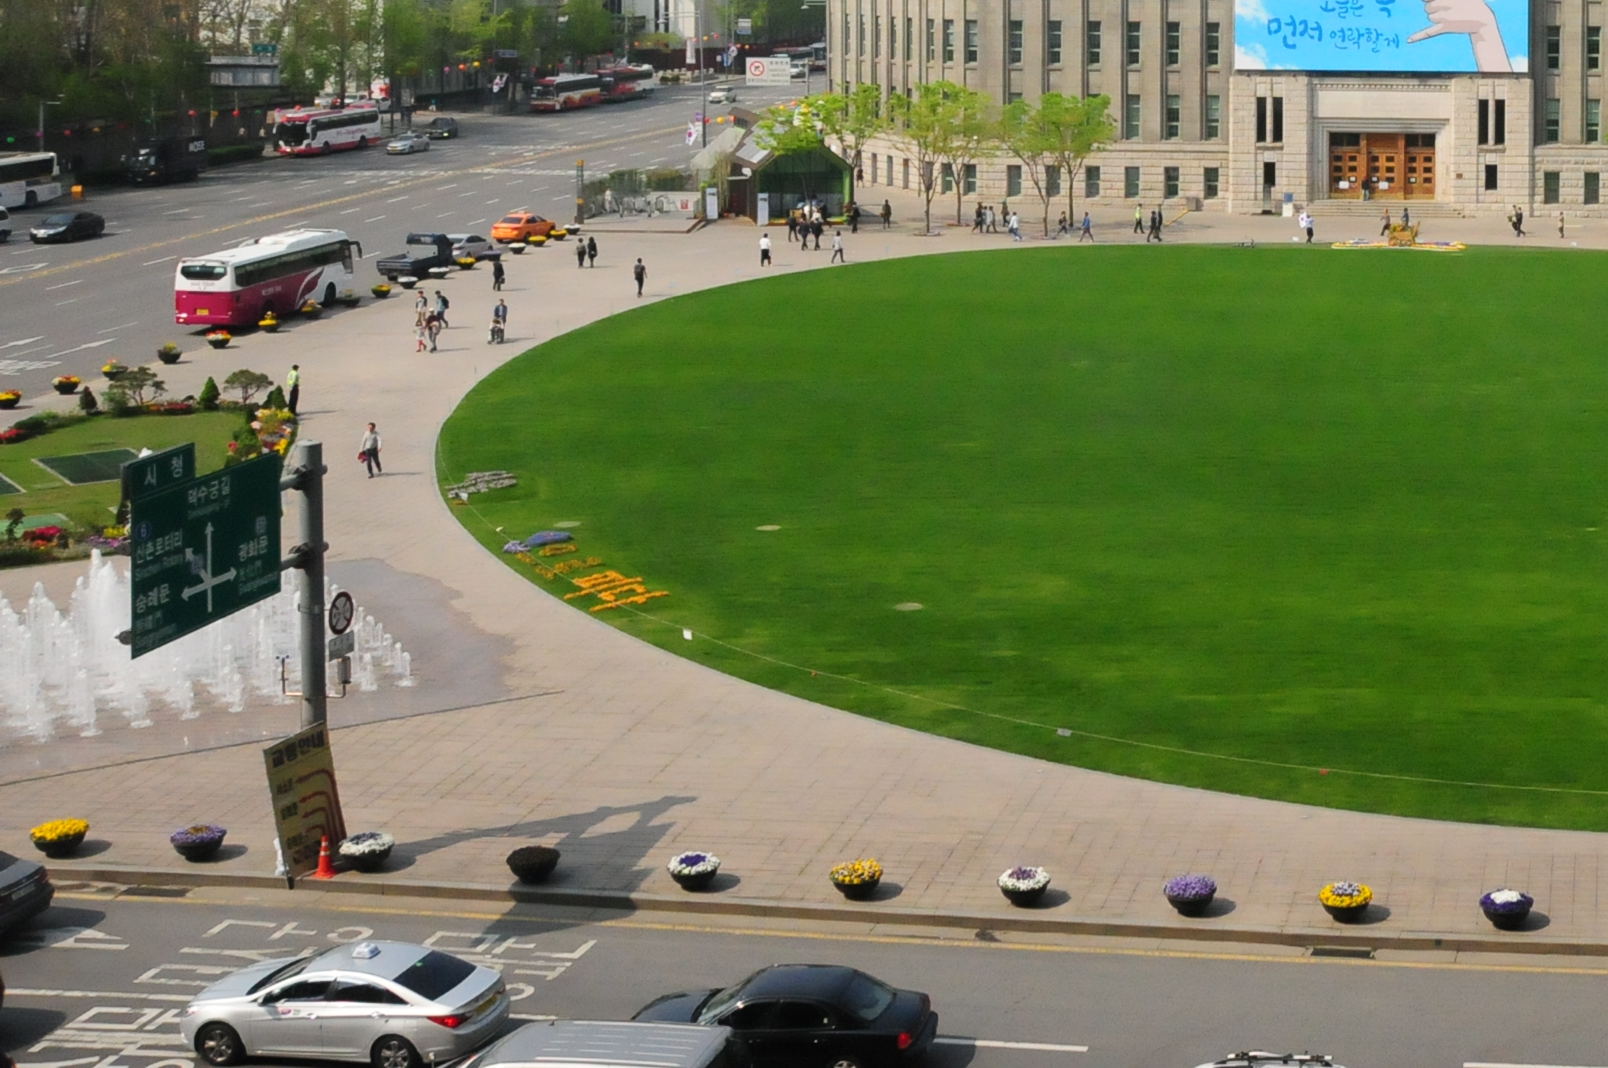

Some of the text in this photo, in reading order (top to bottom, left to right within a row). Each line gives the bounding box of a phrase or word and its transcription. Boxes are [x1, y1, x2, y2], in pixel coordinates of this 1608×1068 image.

[1267, 15, 1323, 49] 먼저
[187, 475, 230, 505] 덕수궁길
[136, 529, 183, 563] 신촌로터리
[238, 535, 268, 562] 광화문
[135, 583, 170, 614] 숭례문
